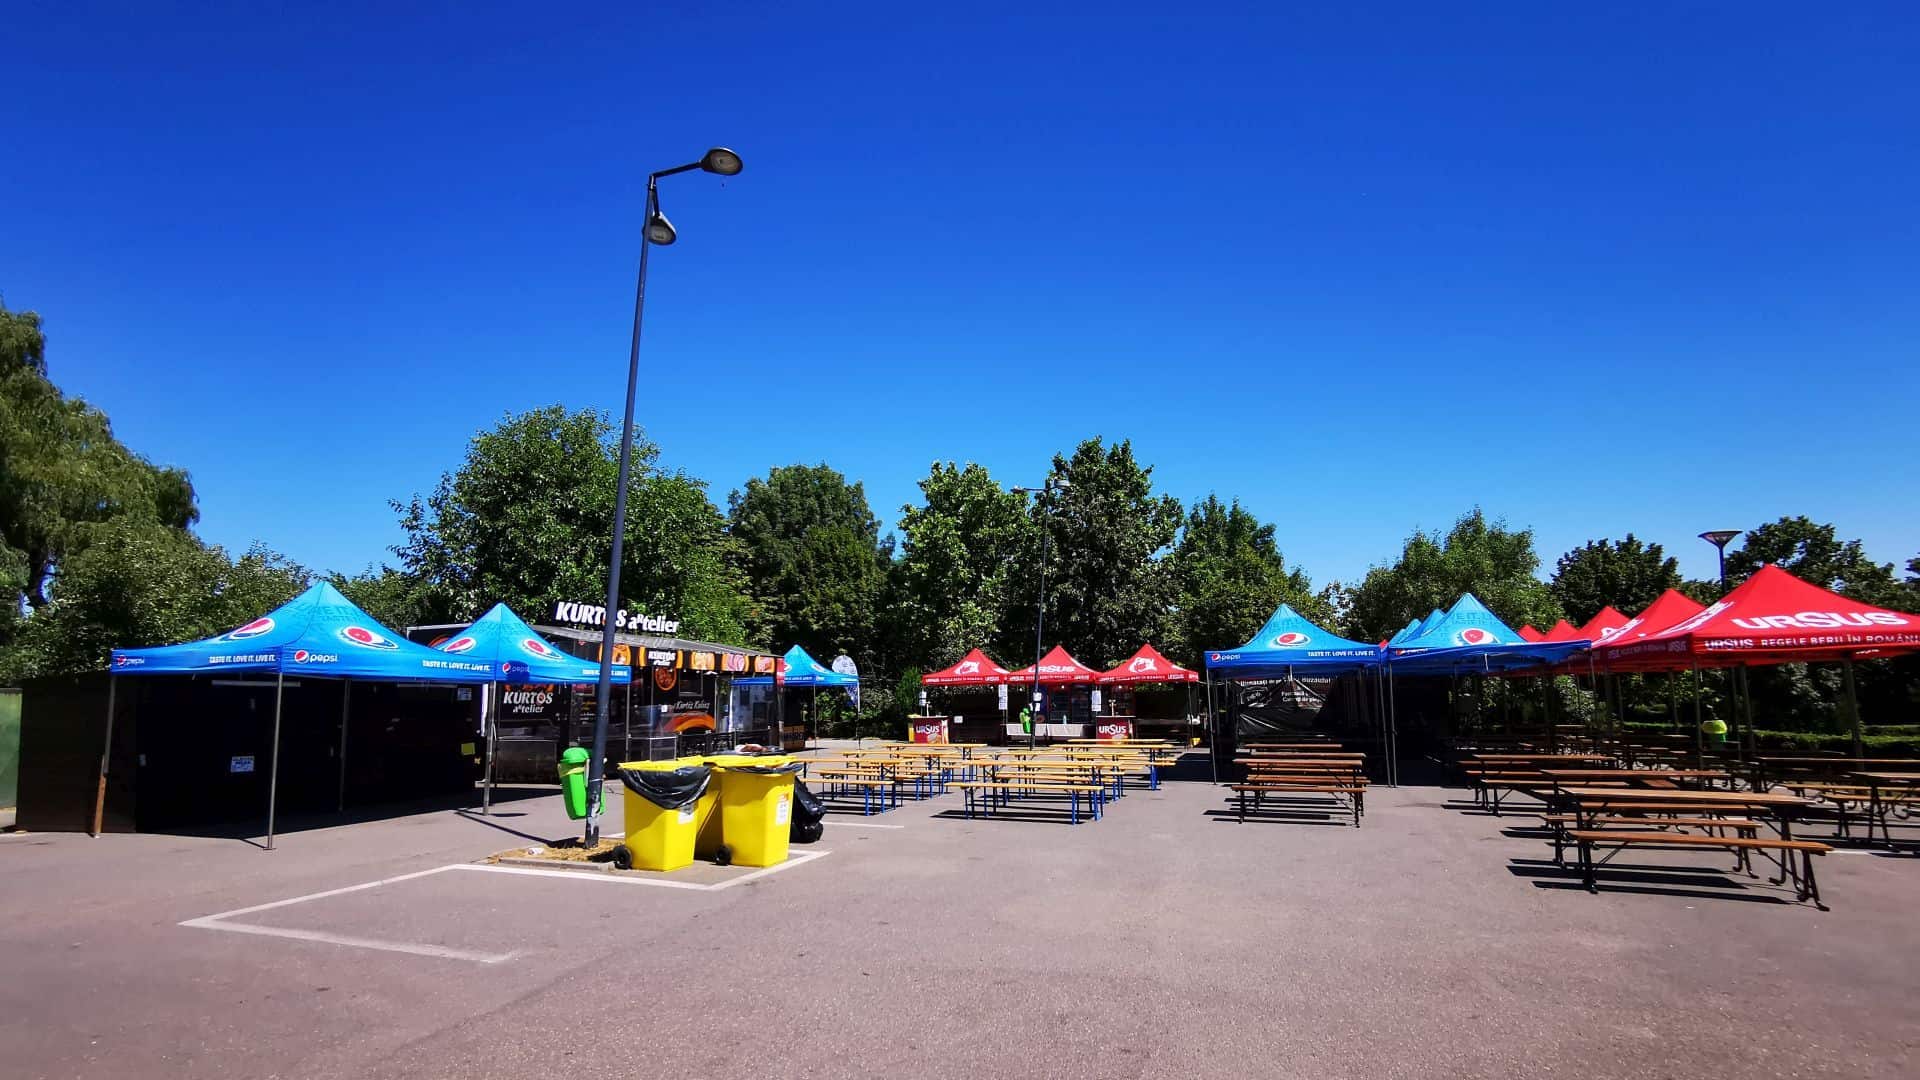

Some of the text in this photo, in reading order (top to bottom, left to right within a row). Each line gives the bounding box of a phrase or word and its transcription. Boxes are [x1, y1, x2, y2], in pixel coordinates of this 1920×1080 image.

[1731, 611, 1909, 629] URSUS
[1704, 638, 1754, 650] URSUS
[1760, 637, 1807, 647] REGELE
[310, 654, 338, 663] pepsi
[915, 724, 940, 734] URSUS
[1098, 724, 1127, 735] URSUS
